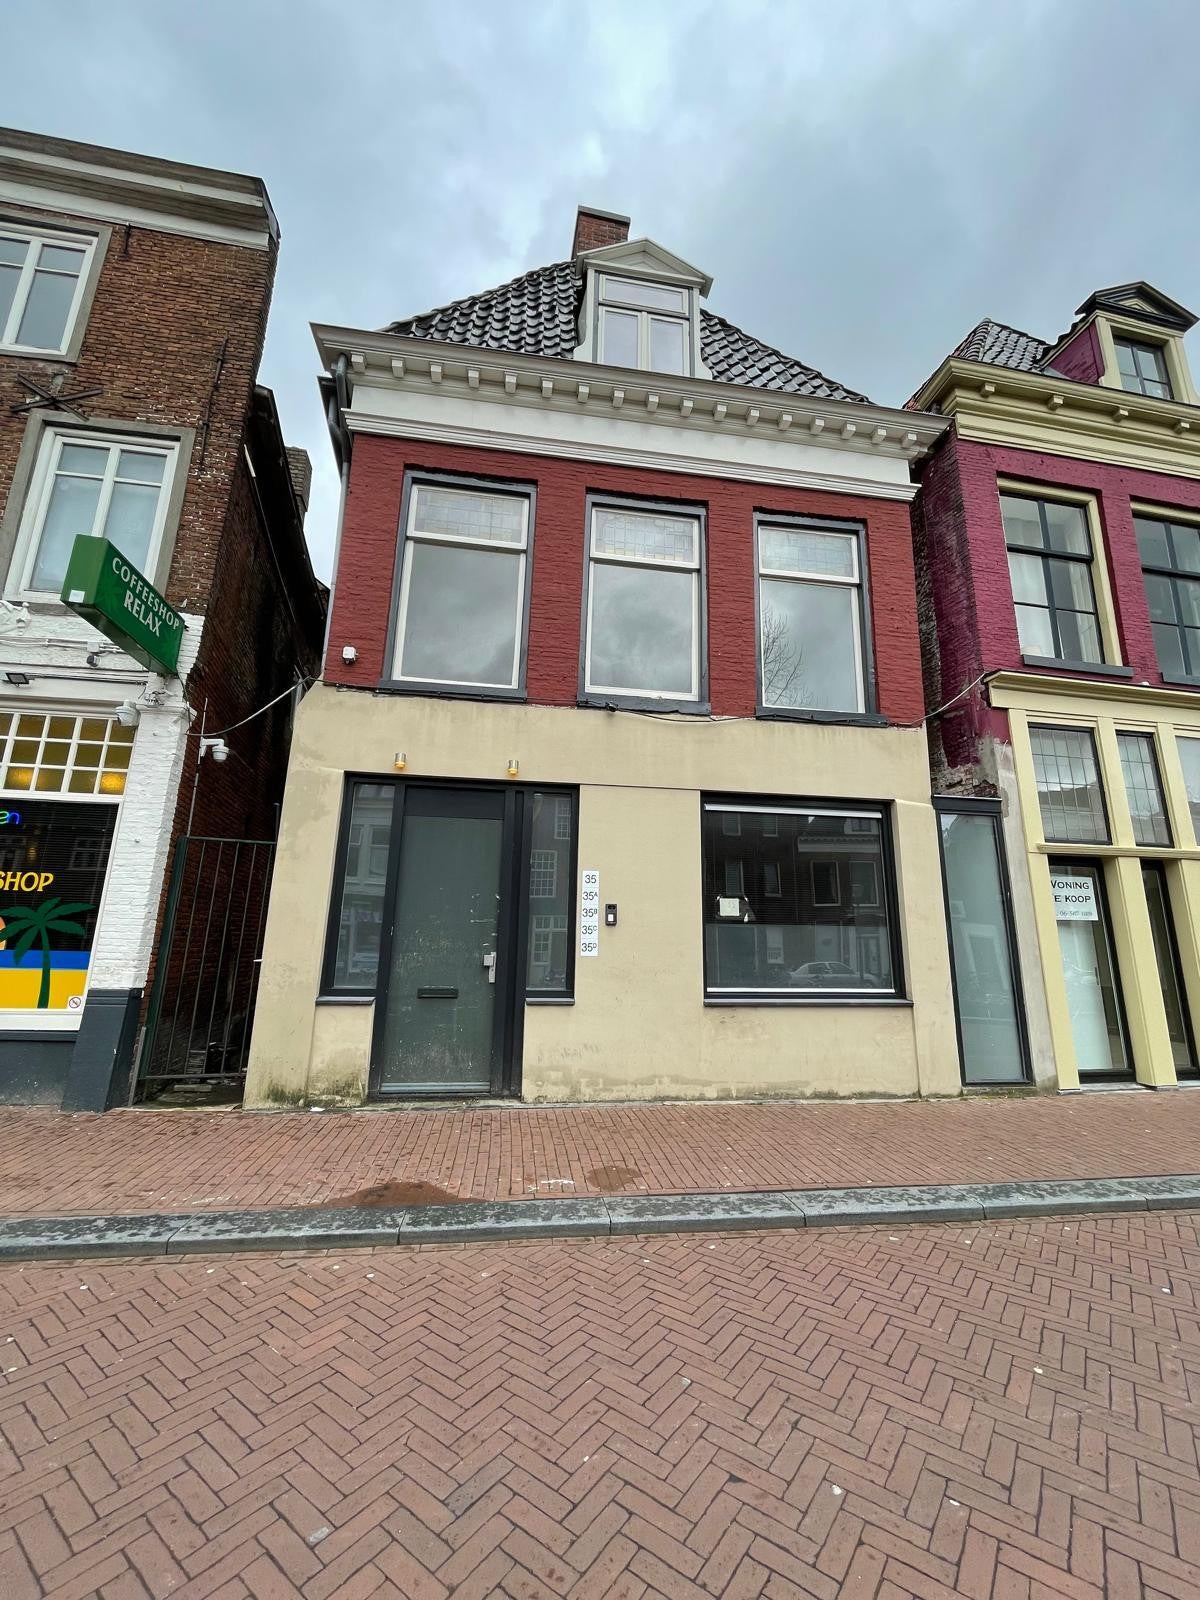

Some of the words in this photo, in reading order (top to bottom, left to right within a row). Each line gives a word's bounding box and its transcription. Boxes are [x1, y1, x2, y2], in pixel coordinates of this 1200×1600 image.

[112, 557, 180, 631] COFFEESHOP
[123, 590, 162, 637] RELAX
[584, 874, 597, 884] 35
[583, 891, 598, 900] 35A
[1064, 894, 1091, 903] KOOP
[582, 908, 598, 918] 35B
[581, 925, 598, 935] 35C
[581, 942, 597, 952] 35D
